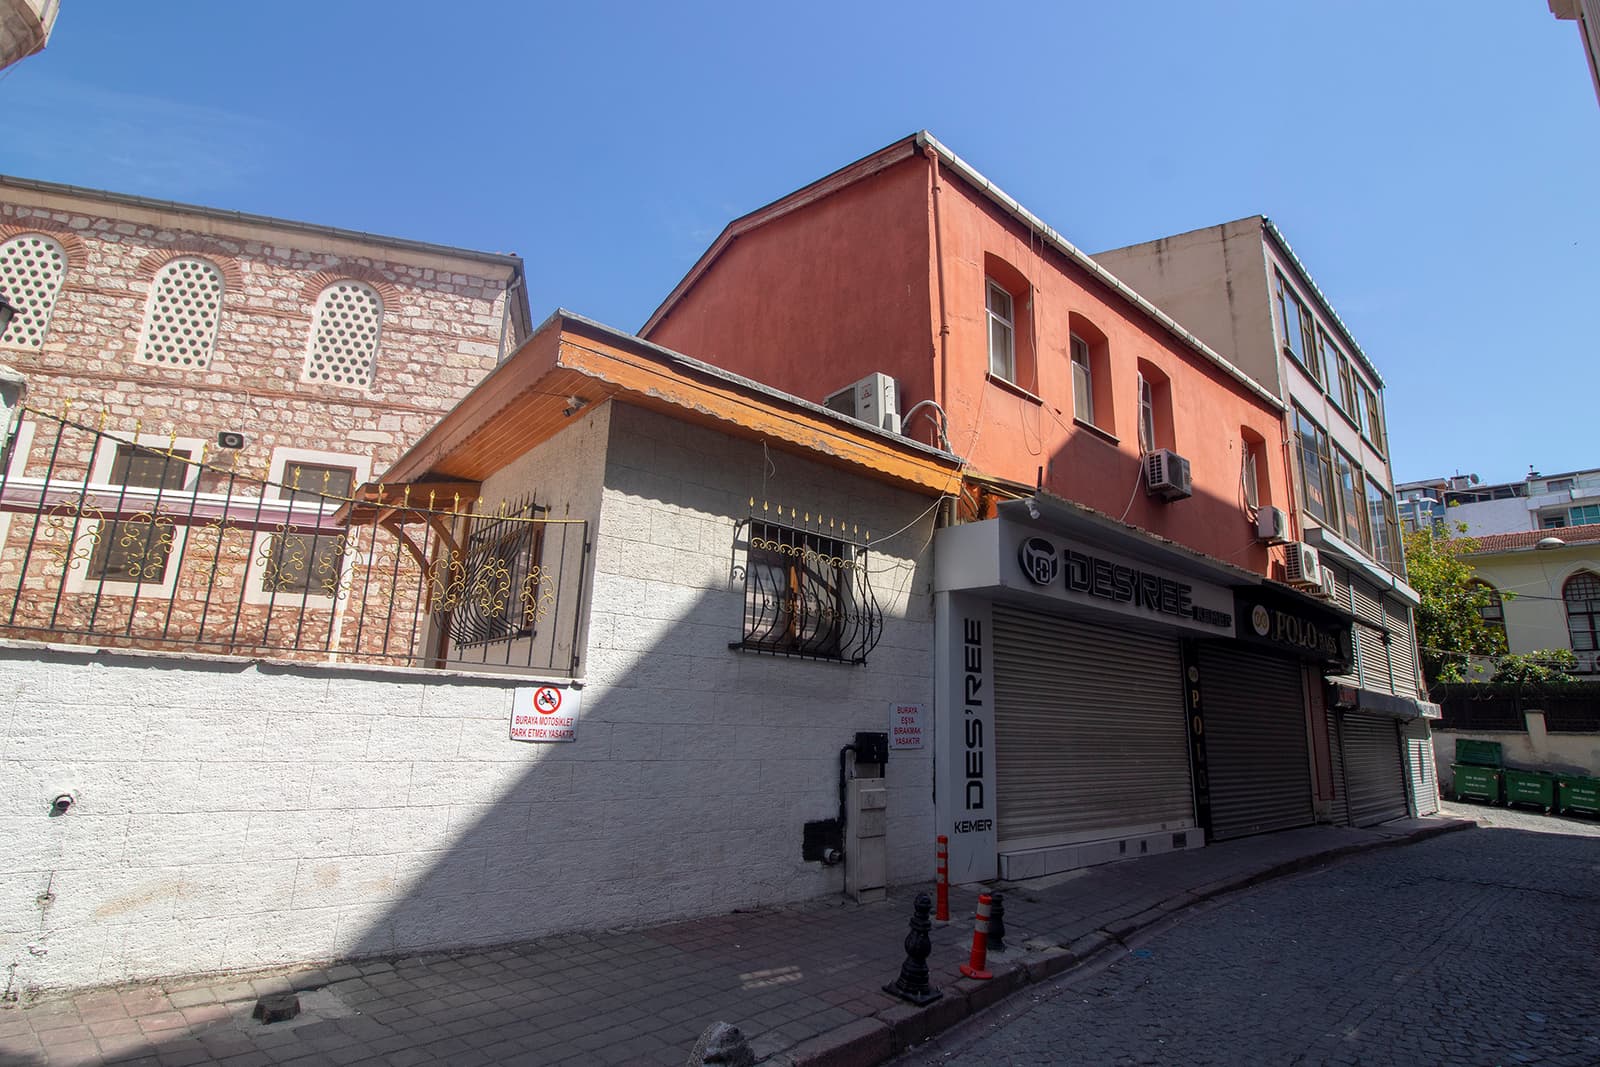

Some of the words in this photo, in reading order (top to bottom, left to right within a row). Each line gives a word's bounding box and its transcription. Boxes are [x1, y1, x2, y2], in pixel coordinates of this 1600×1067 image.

[1192, 606, 1232, 628] KEMER
[1272, 610, 1317, 649] POLO
[896, 706, 917, 714] BURAYA
[964, 618, 984, 810] DES'REE
[515, 715, 538, 725] BURAYA
[511, 728, 527, 737] PARK
[528, 728, 547, 738] ETMEK
[548, 729, 575, 739] YASAKTIR
[896, 737, 920, 745] YASAKTIR
[954, 820, 993, 834] KEMER
